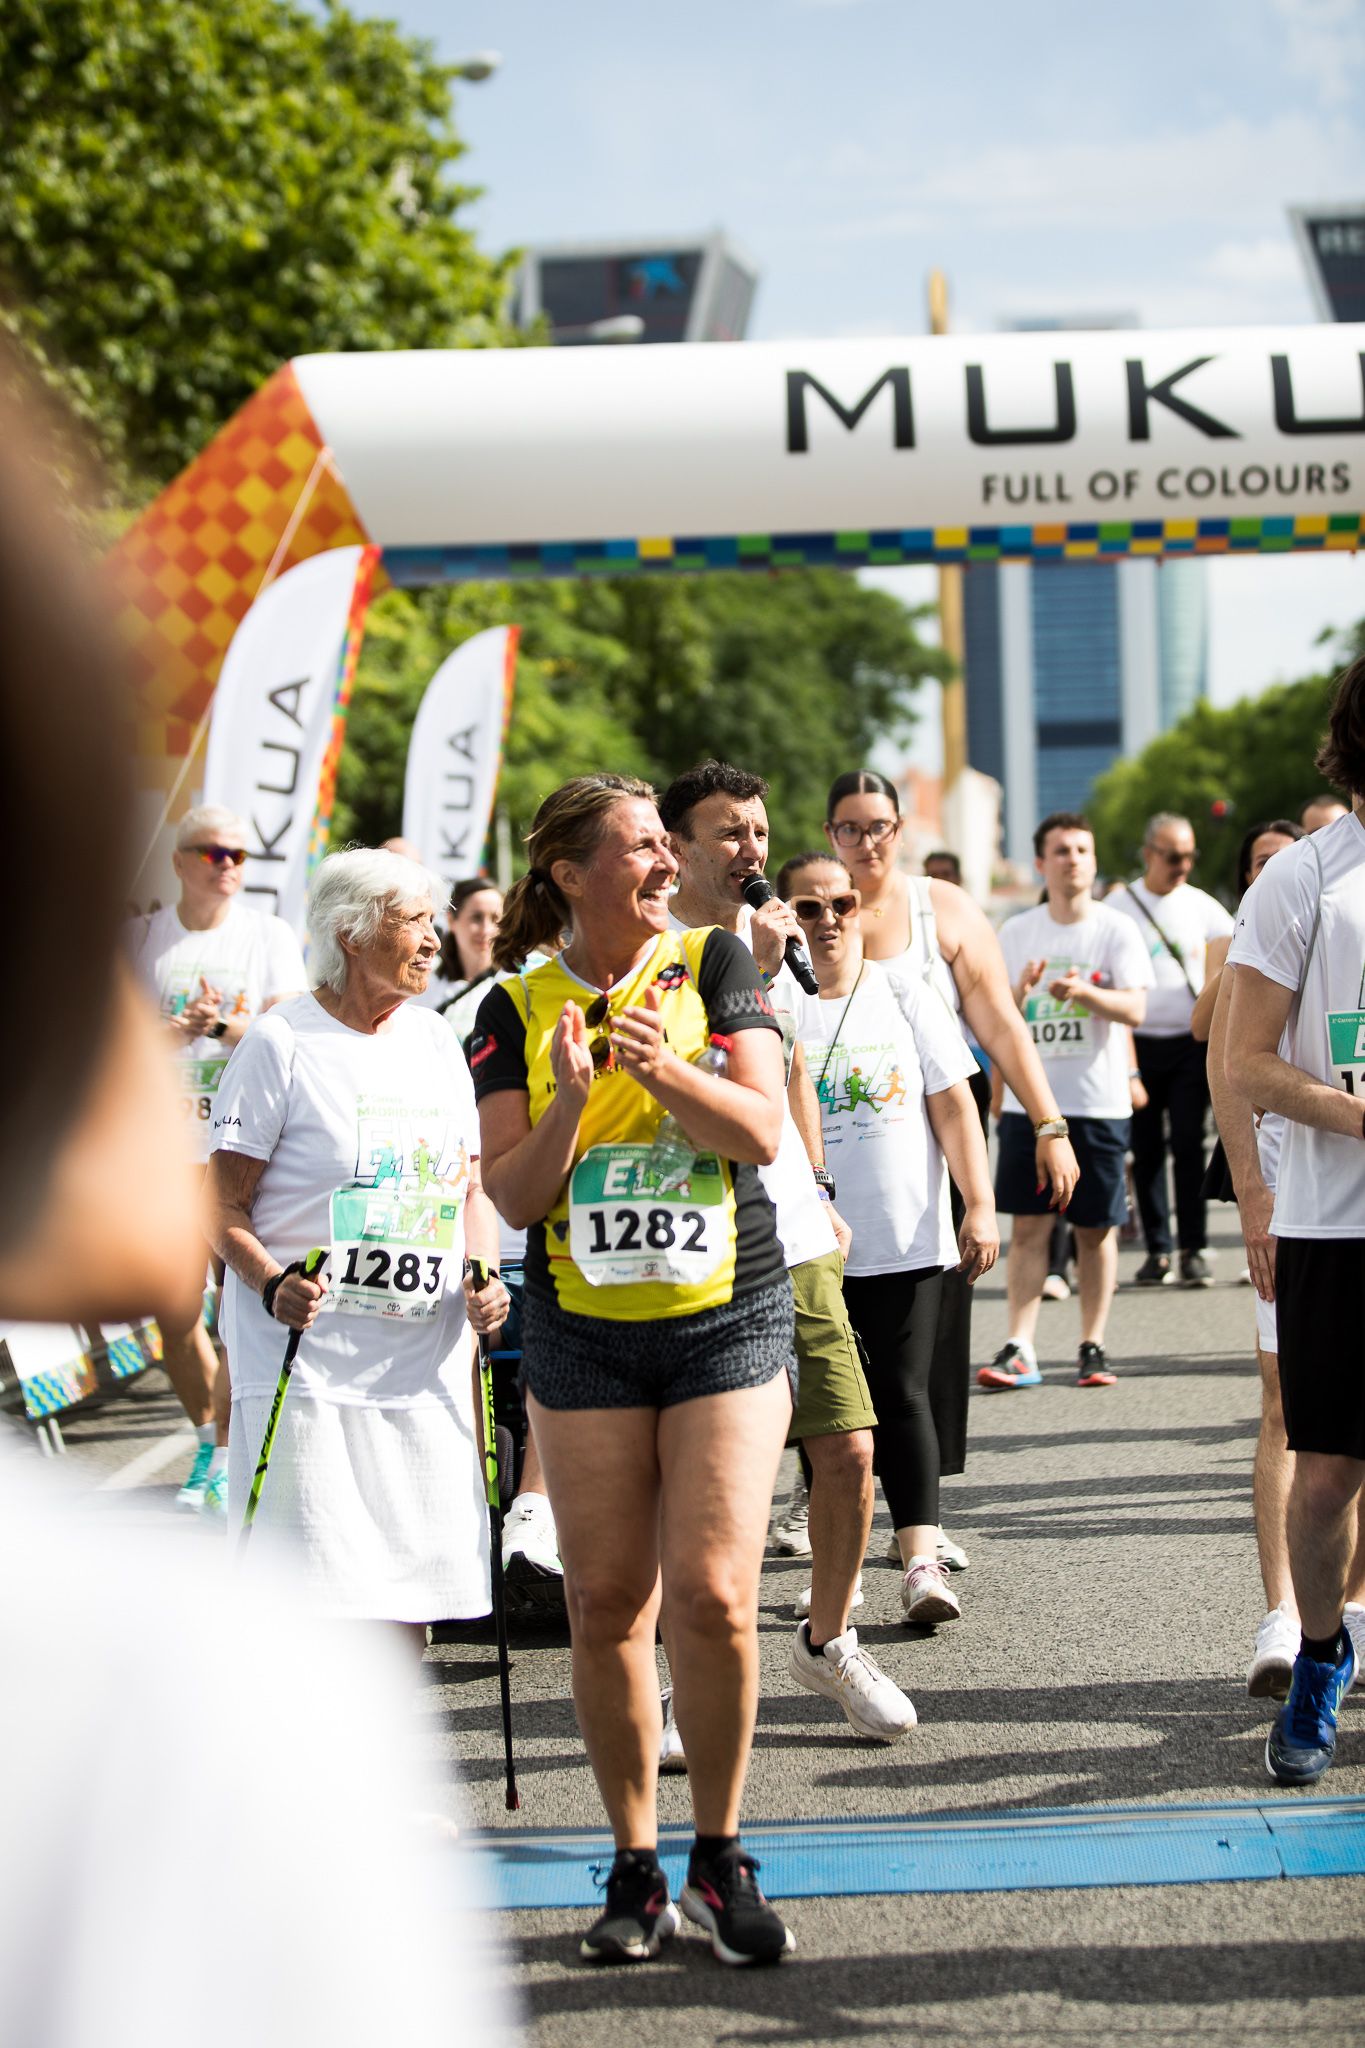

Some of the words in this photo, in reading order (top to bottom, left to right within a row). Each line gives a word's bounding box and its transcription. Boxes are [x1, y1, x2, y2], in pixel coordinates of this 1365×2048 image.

[786, 352, 1365, 453] MUKU
[981, 474, 1074, 506] FULL
[1088, 469, 1141, 500] OF
[1156, 462, 1352, 500] COLOURS
[438, 722, 478, 860] KUA
[1032, 1020, 1084, 1044] 1021
[589, 1208, 708, 1254] 1282
[340, 1247, 443, 1295] 1283
